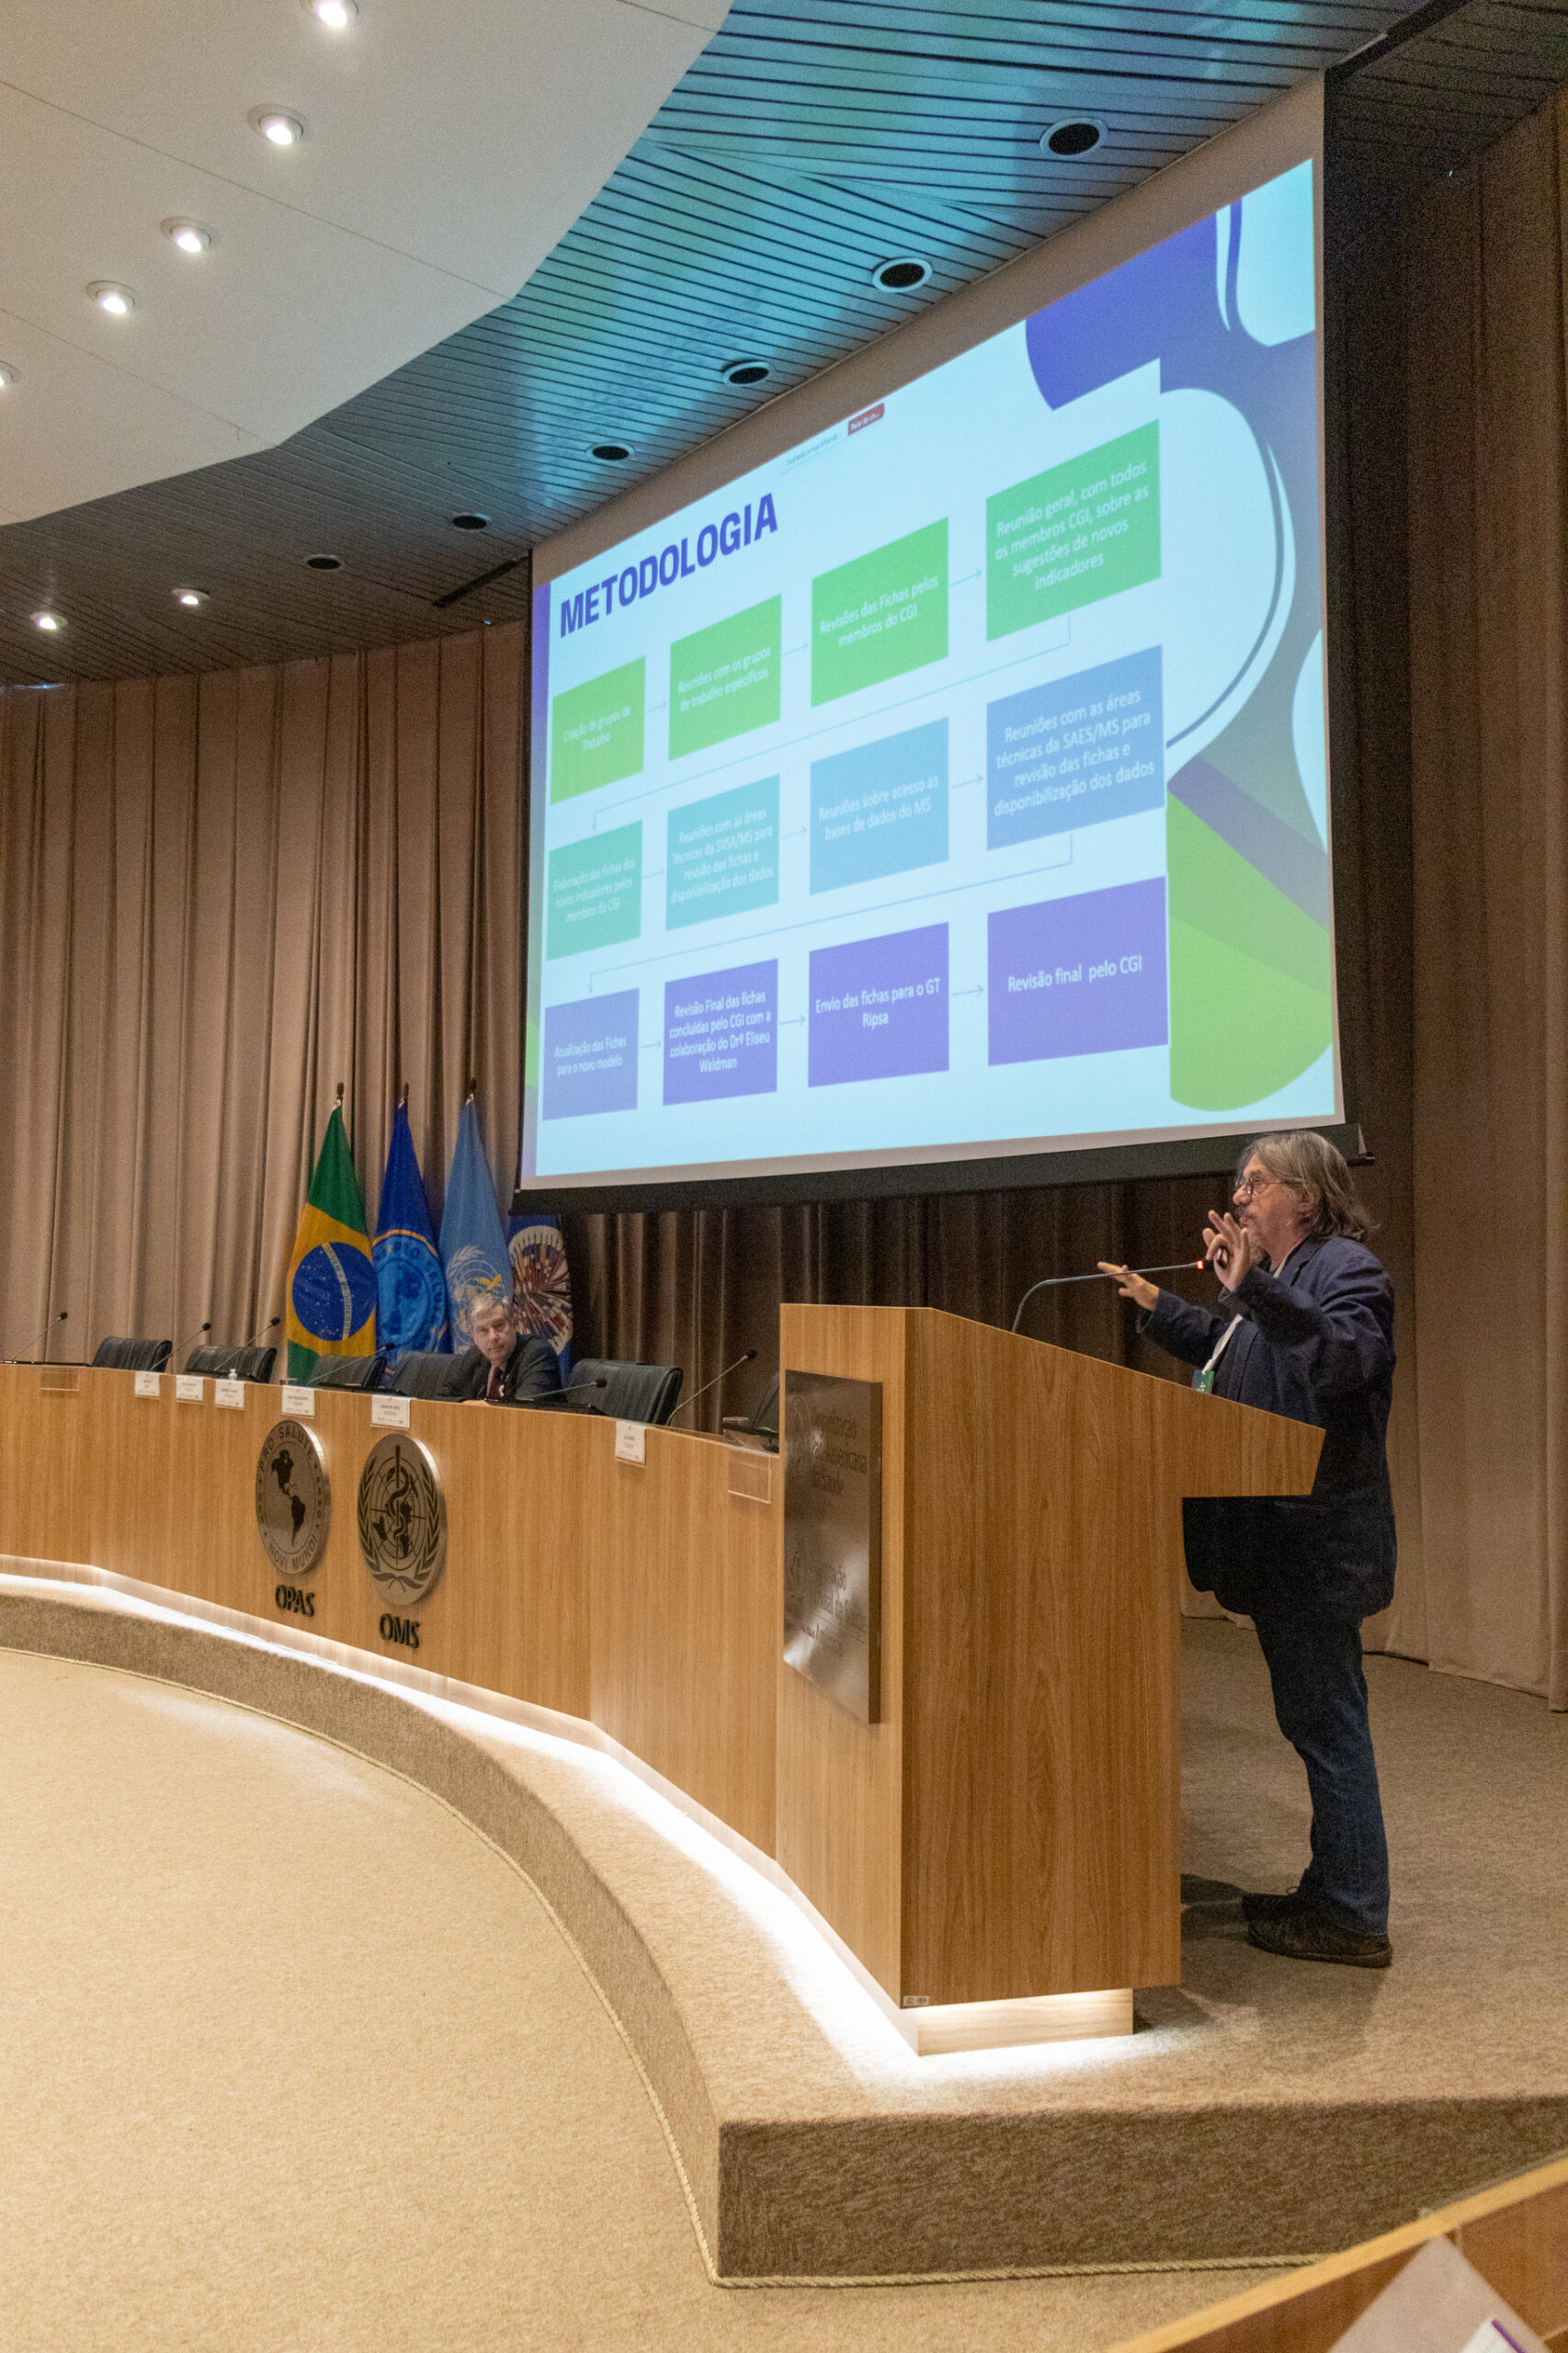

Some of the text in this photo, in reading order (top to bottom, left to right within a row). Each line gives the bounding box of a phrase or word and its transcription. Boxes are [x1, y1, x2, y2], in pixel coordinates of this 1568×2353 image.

[996, 460, 1147, 538] Reunião geral, com todos
[994, 485, 1149, 561] os membros CGI, sobre as
[560, 493, 778, 638] METODOLOGIA
[1013, 518, 1129, 577] sugestões de novos
[1034, 552, 1104, 591] indicadores
[820, 575, 939, 636] Revisões das Fichas pelos
[838, 603, 917, 648] membros do CGI
[678, 647, 771, 695] Reuniões com os grupos
[680, 699, 690, 712] de
[691, 686, 723, 709] trabalho
[1005, 689, 1141, 744] Reuniões com as áreas
[995, 712, 1151, 769] técnicas da SAES/MS para
[1014, 743, 1131, 789] revisão das fichas e
[818, 797, 860, 824] Reuniões
[862, 790, 890, 810] sobre
[892, 779, 925, 801] acesso
[994, 761, 1155, 818] disponibilização dos dados
[678, 809, 767, 845] Reuniões com as áreas
[755, 826, 773, 845] para
[824, 796, 932, 841] bases de dados do MS
[670, 865, 774, 904] disponibilização dos dados
[684, 862, 711, 881] revisão
[712, 858, 727, 872] das
[728, 852, 752, 871] fichas
[1007, 954, 1142, 993] Revisão final pelo CGI
[675, 989, 766, 1018] Revisão Final das fichas
[815, 978, 941, 1014] Envio das fichas para o GT
[710, 1017, 728, 1035] pelo
[730, 1013, 744, 1029] CGI
[745, 1012, 764, 1026] com
[766, 1011, 771, 1022] a
[862, 1011, 889, 1029] Ripsa
[554, 1040, 591, 1058] Atualização
[592, 1038, 604, 1052] das
[669, 1038, 716, 1058] colaboração
[717, 1036, 729, 1050] do
[745, 1031, 770, 1047] Eliseu
[557, 1064, 572, 1079] para
[578, 1059, 596, 1073] novo
[596, 1053, 623, 1070] modelo
[699, 1056, 737, 1074] Waldman
[259, 1426, 314, 1472] PRO SALUTE
[275, 1585, 315, 1618] OPAS
[379, 1613, 420, 1648] OMS
